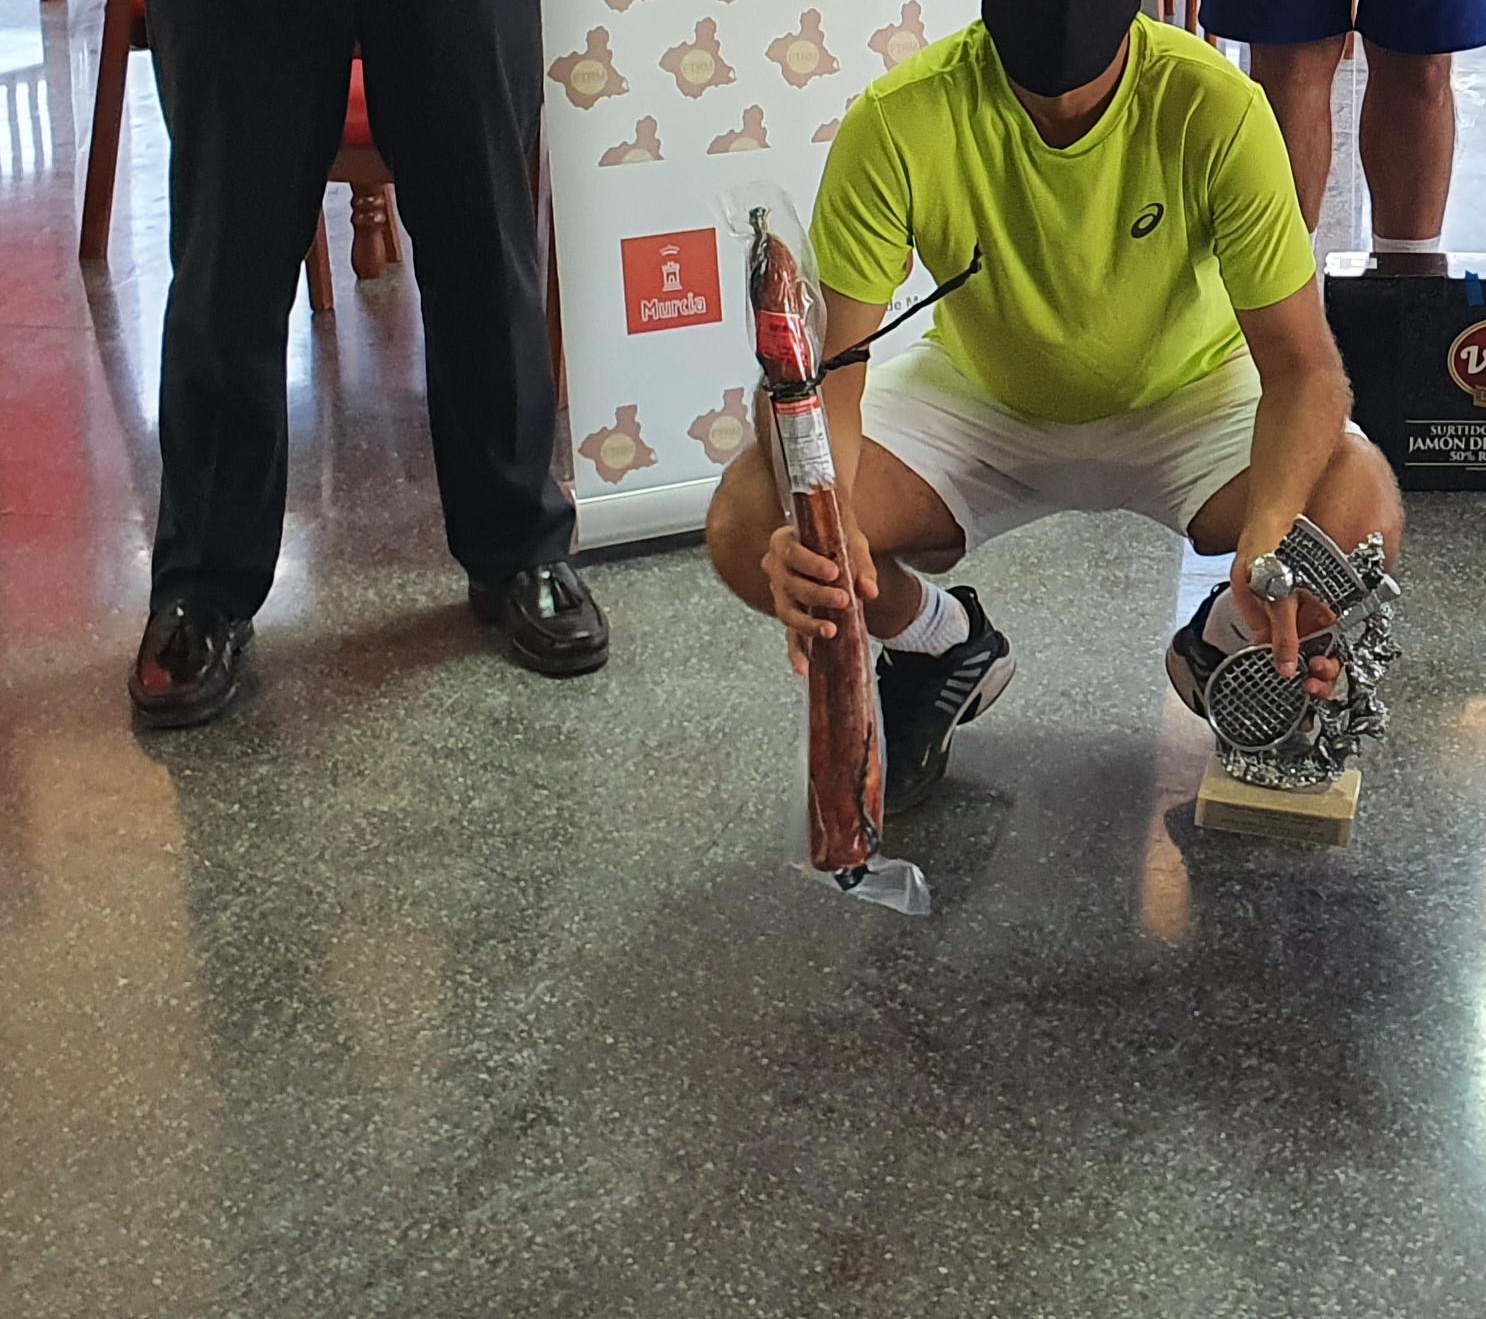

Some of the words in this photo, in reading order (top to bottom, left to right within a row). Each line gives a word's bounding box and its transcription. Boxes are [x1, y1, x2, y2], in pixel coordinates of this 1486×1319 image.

[641, 292, 706, 321] Murcia
[1408, 433, 1465, 453] JAMÓN
[1449, 451, 1475, 462] 50%
